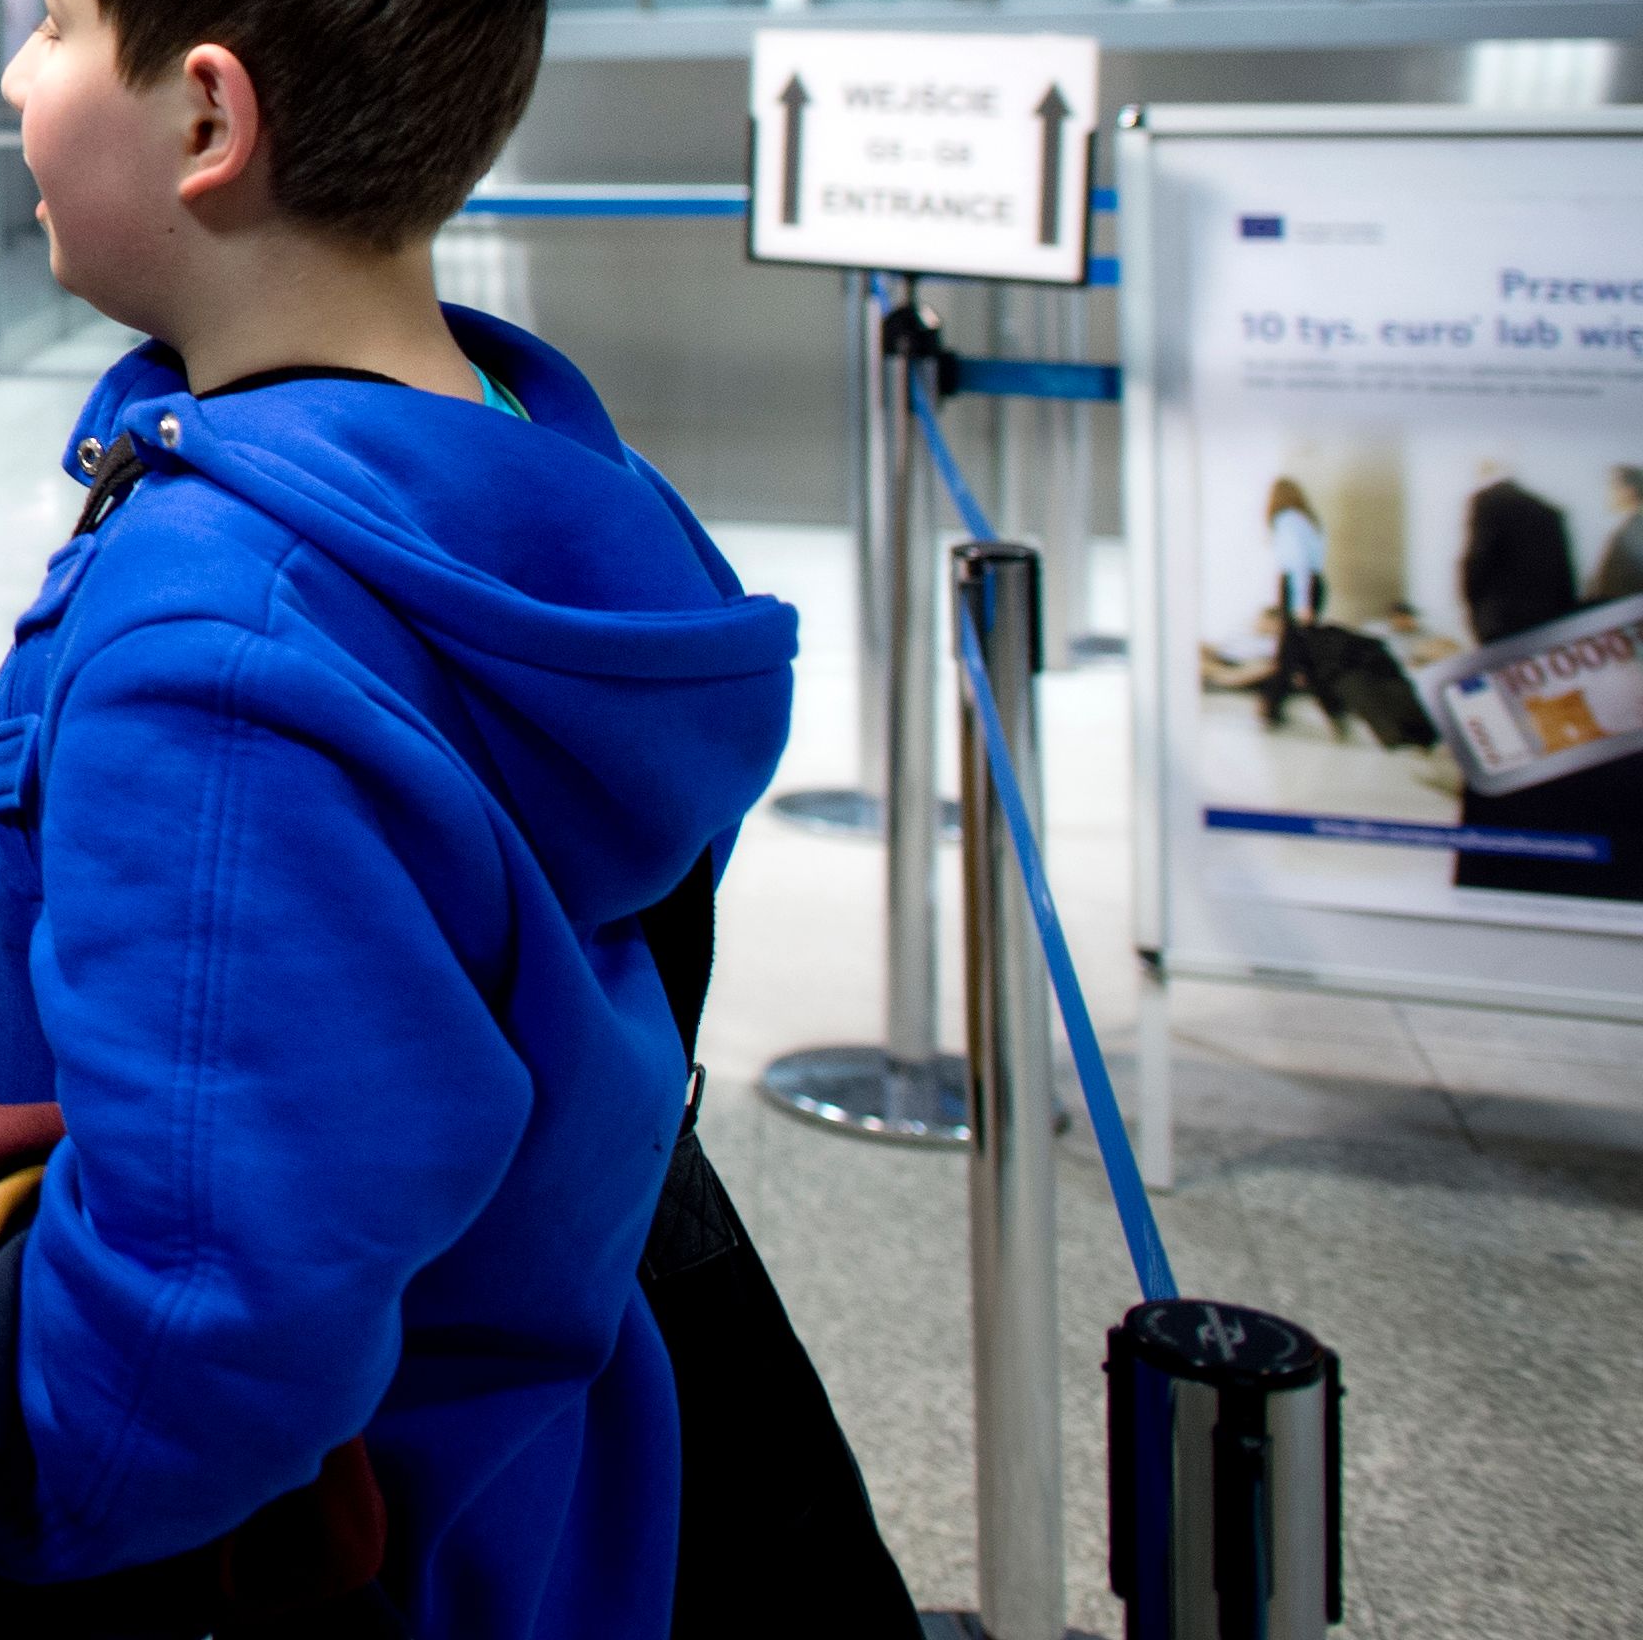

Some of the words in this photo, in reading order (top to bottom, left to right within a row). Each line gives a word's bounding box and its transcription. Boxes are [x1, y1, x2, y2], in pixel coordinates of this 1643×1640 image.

[840, 78, 1001, 118] WEJŚCIE
[820, 182, 1018, 226] ENTRANCE
[1241, 311, 1287, 344] 10
